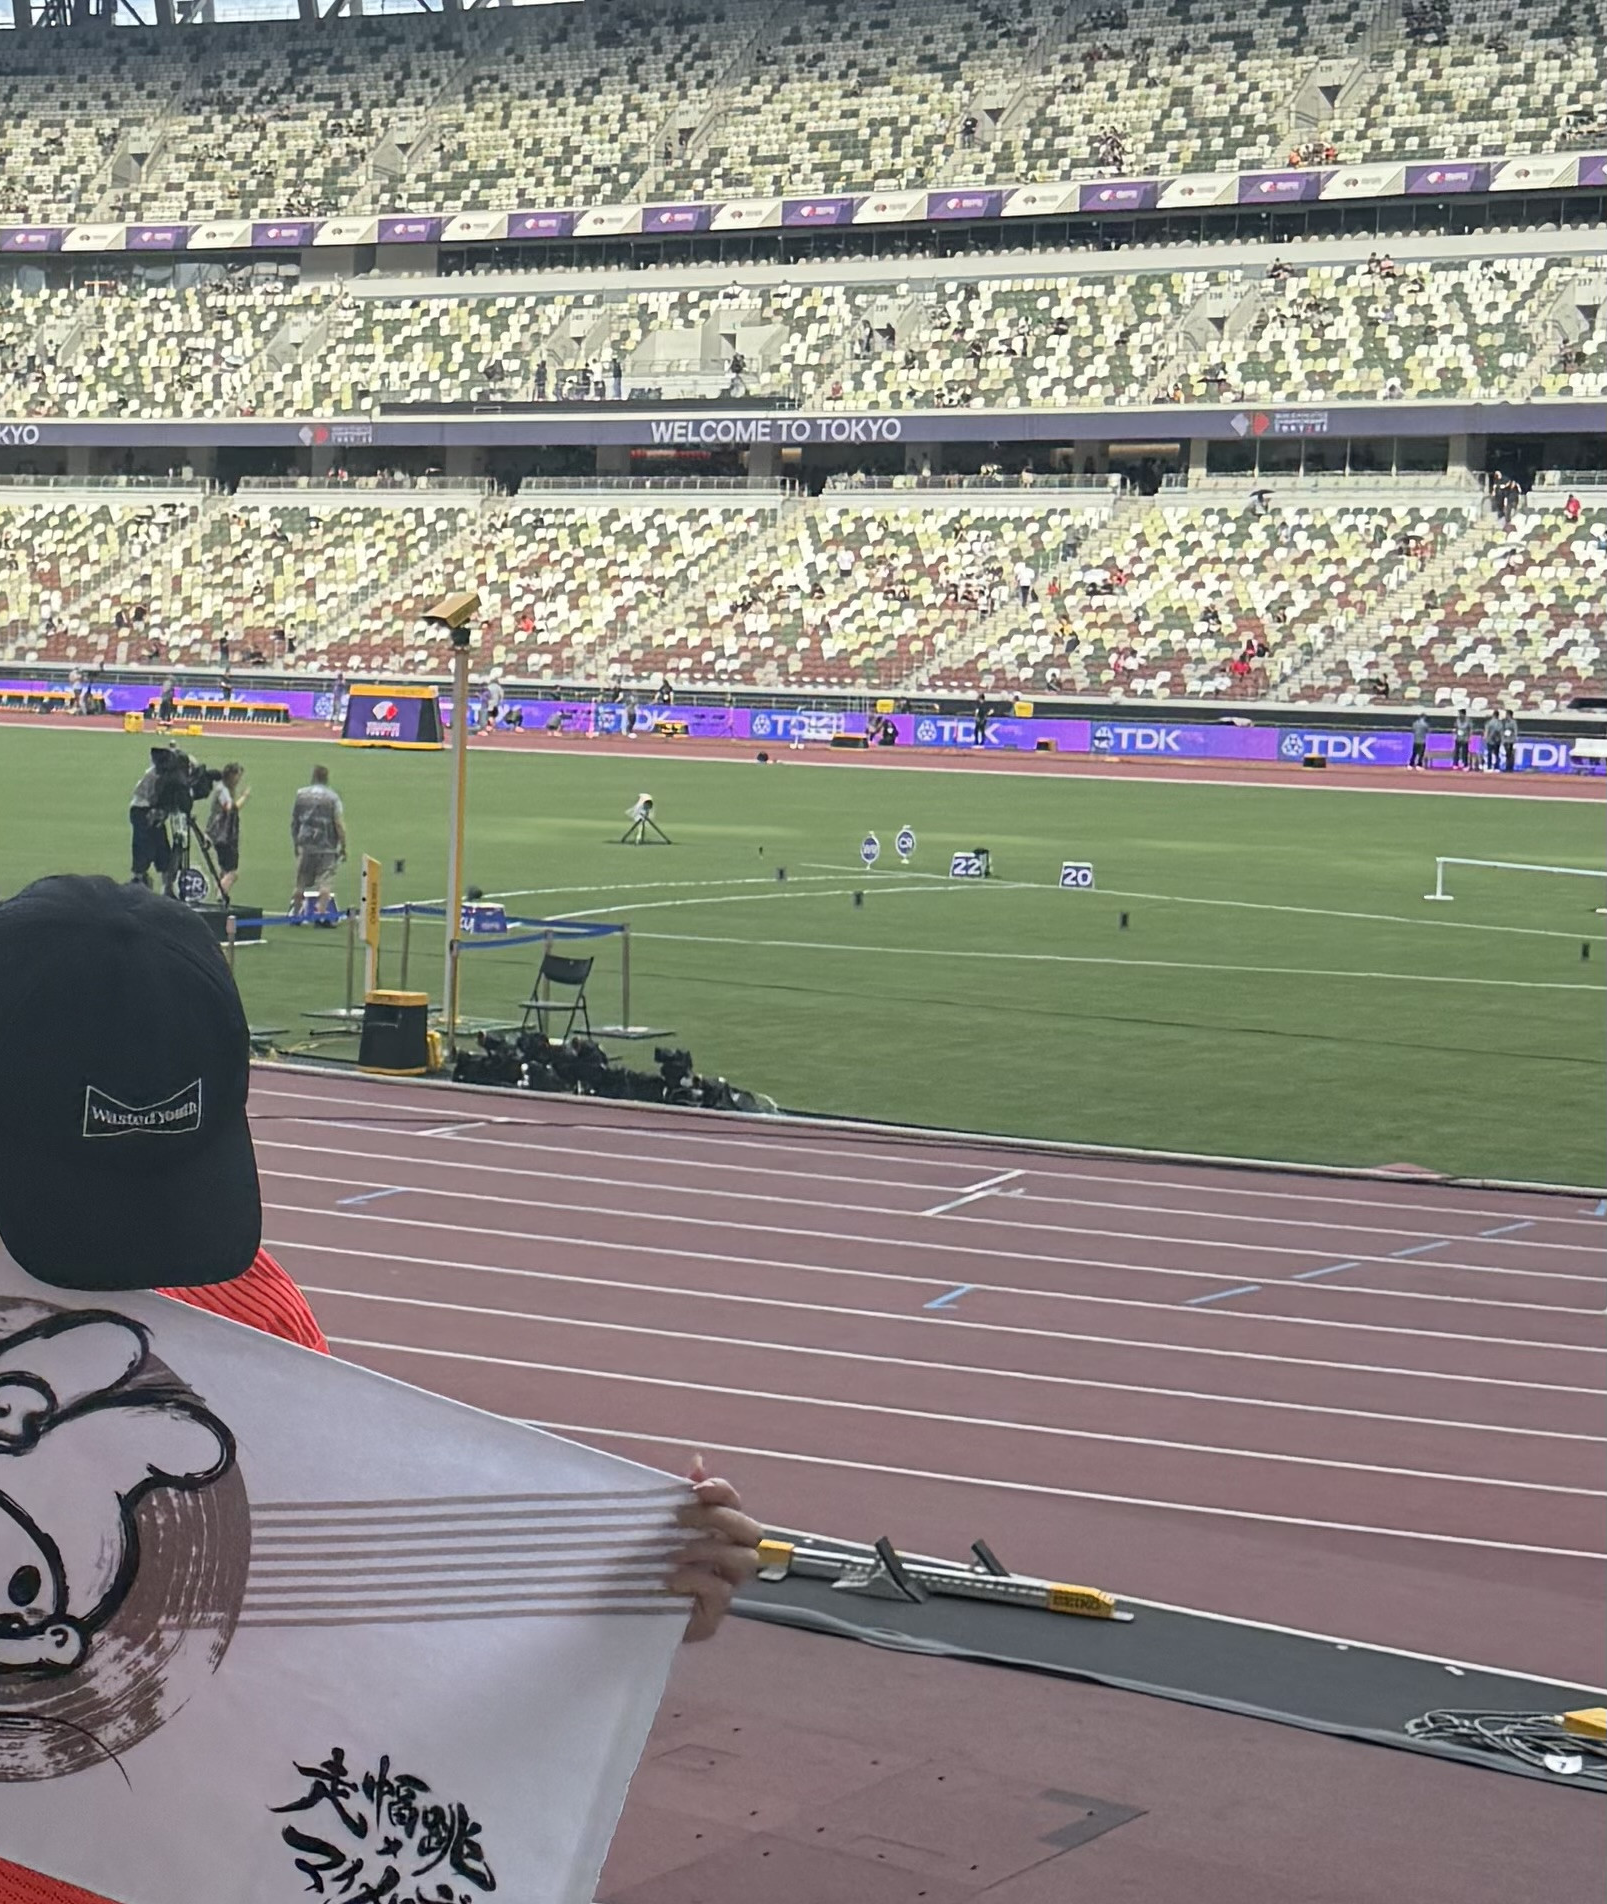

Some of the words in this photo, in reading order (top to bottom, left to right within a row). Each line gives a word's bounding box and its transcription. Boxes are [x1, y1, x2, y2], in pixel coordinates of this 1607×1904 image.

[651, 419, 772, 443] WELCOME
[777, 419, 811, 442] TO
[816, 418, 902, 442] TOKYO
[1113, 727, 1182, 752] TDK
[1303, 734, 1377, 760] TDK
[953, 858, 982, 875] 22
[1062, 869, 1093, 886] 20
